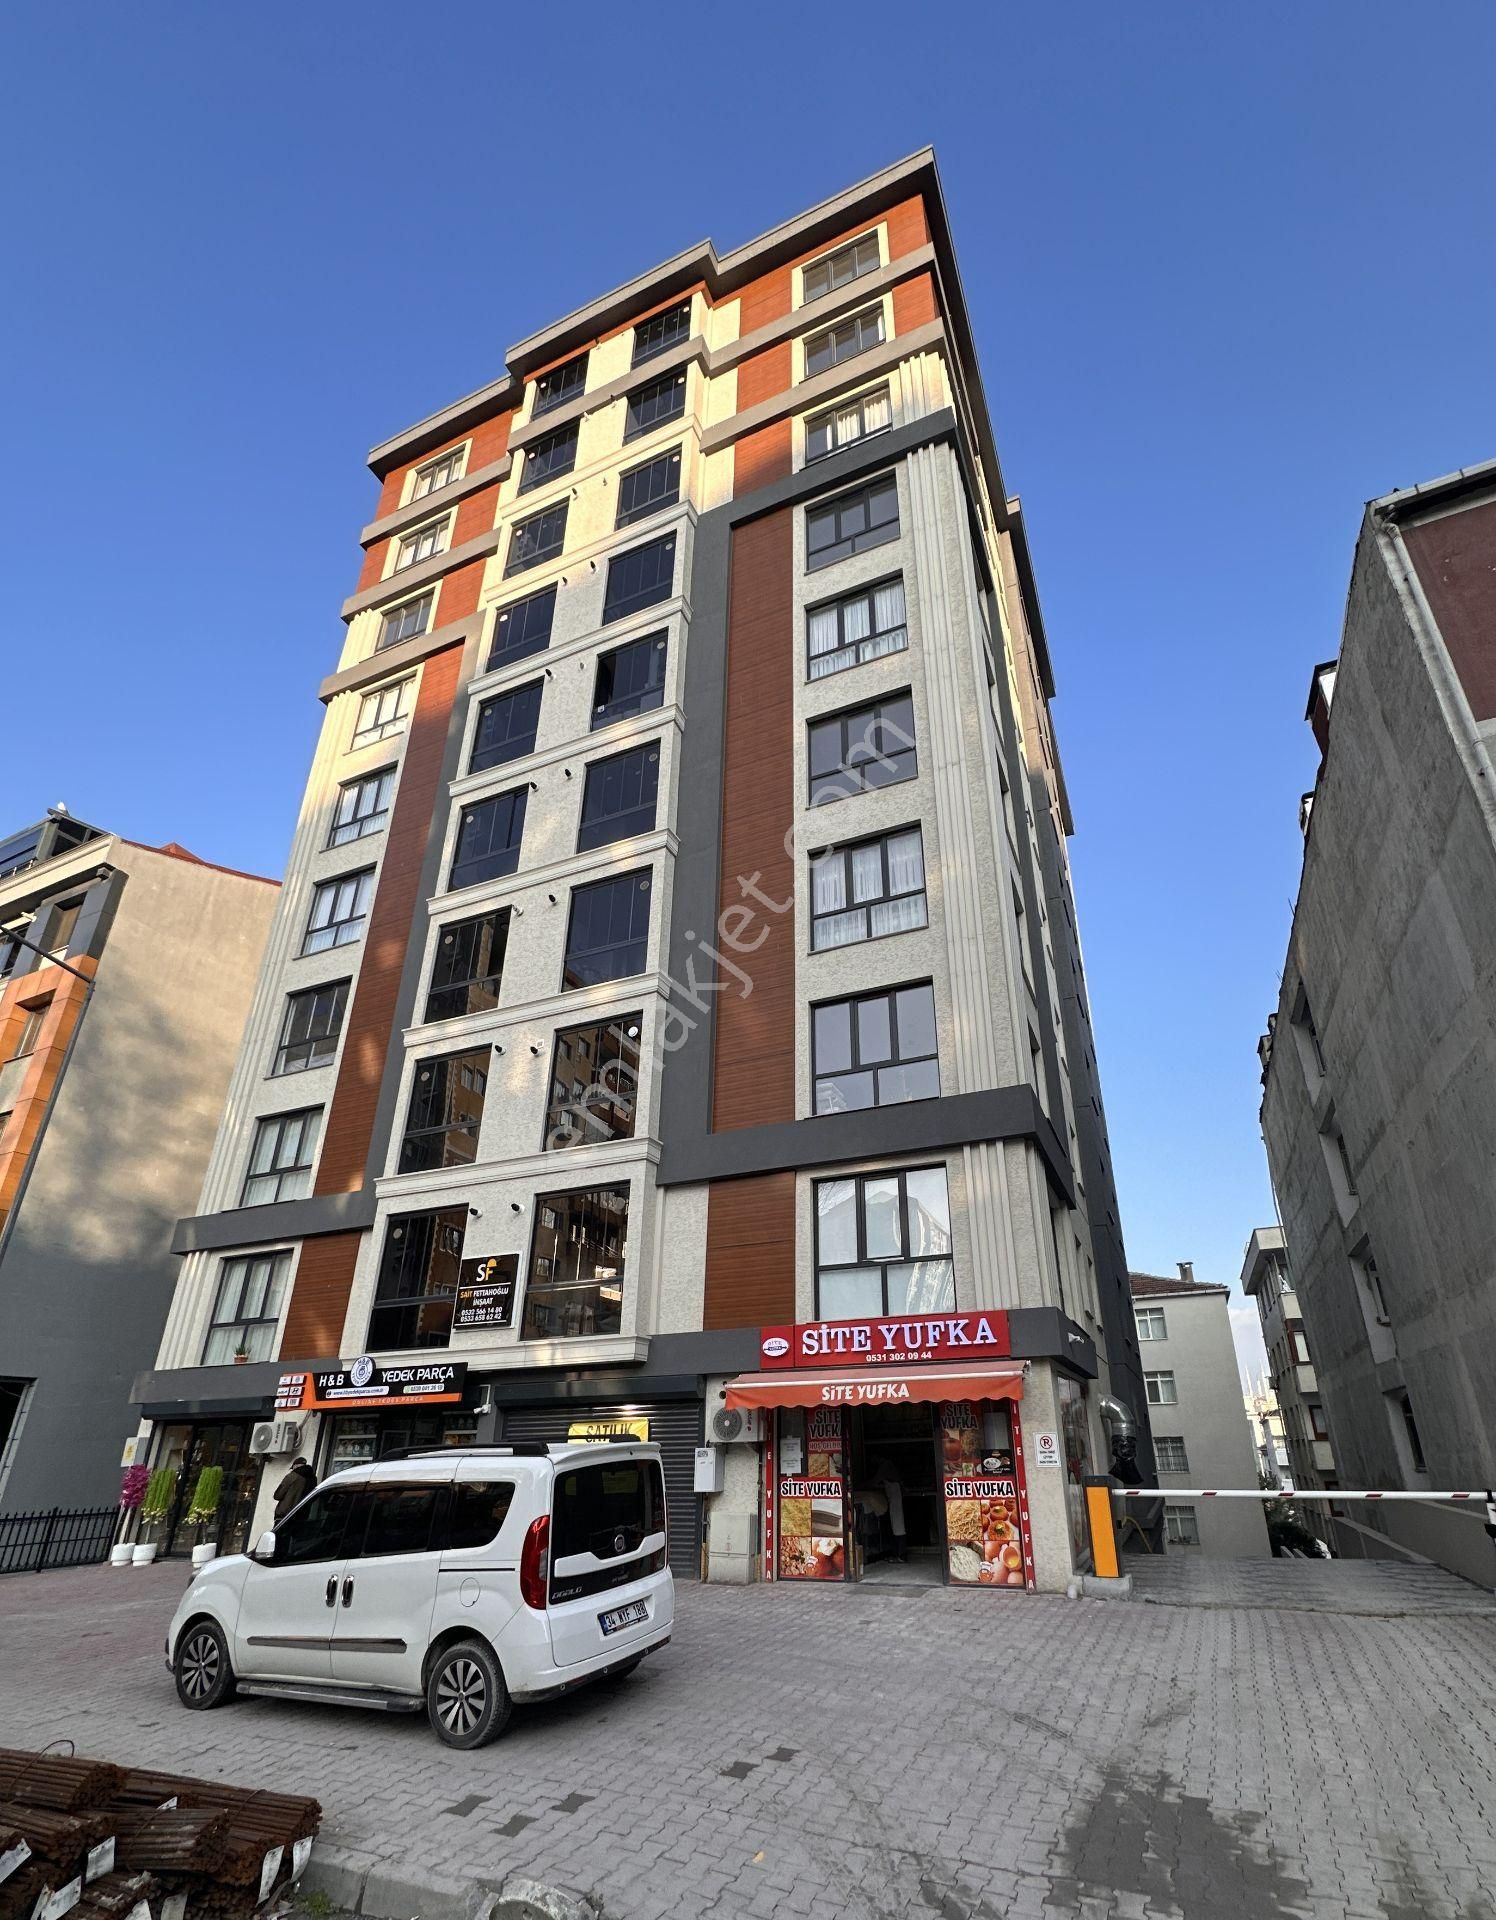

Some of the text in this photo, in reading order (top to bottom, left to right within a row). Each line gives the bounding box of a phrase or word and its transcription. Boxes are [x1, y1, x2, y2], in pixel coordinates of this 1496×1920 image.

[802, 1317, 997, 1355] SİTE YUFKA
[866, 1352, 932, 1362] 0531 302 09 44
[381, 1370, 413, 1383] YEDEK
[416, 1366, 454, 1383] PARÇA
[822, 1383, 909, 1400] SİTE YUFKA
[941, 1415, 978, 1429] YUFKA
[808, 1423, 841, 1439] YUFK
[781, 1478, 842, 1497] SİTE YUFKA
[945, 1478, 1015, 1497] SİTE YUFKA
[605, 1613, 616, 1628] 34
